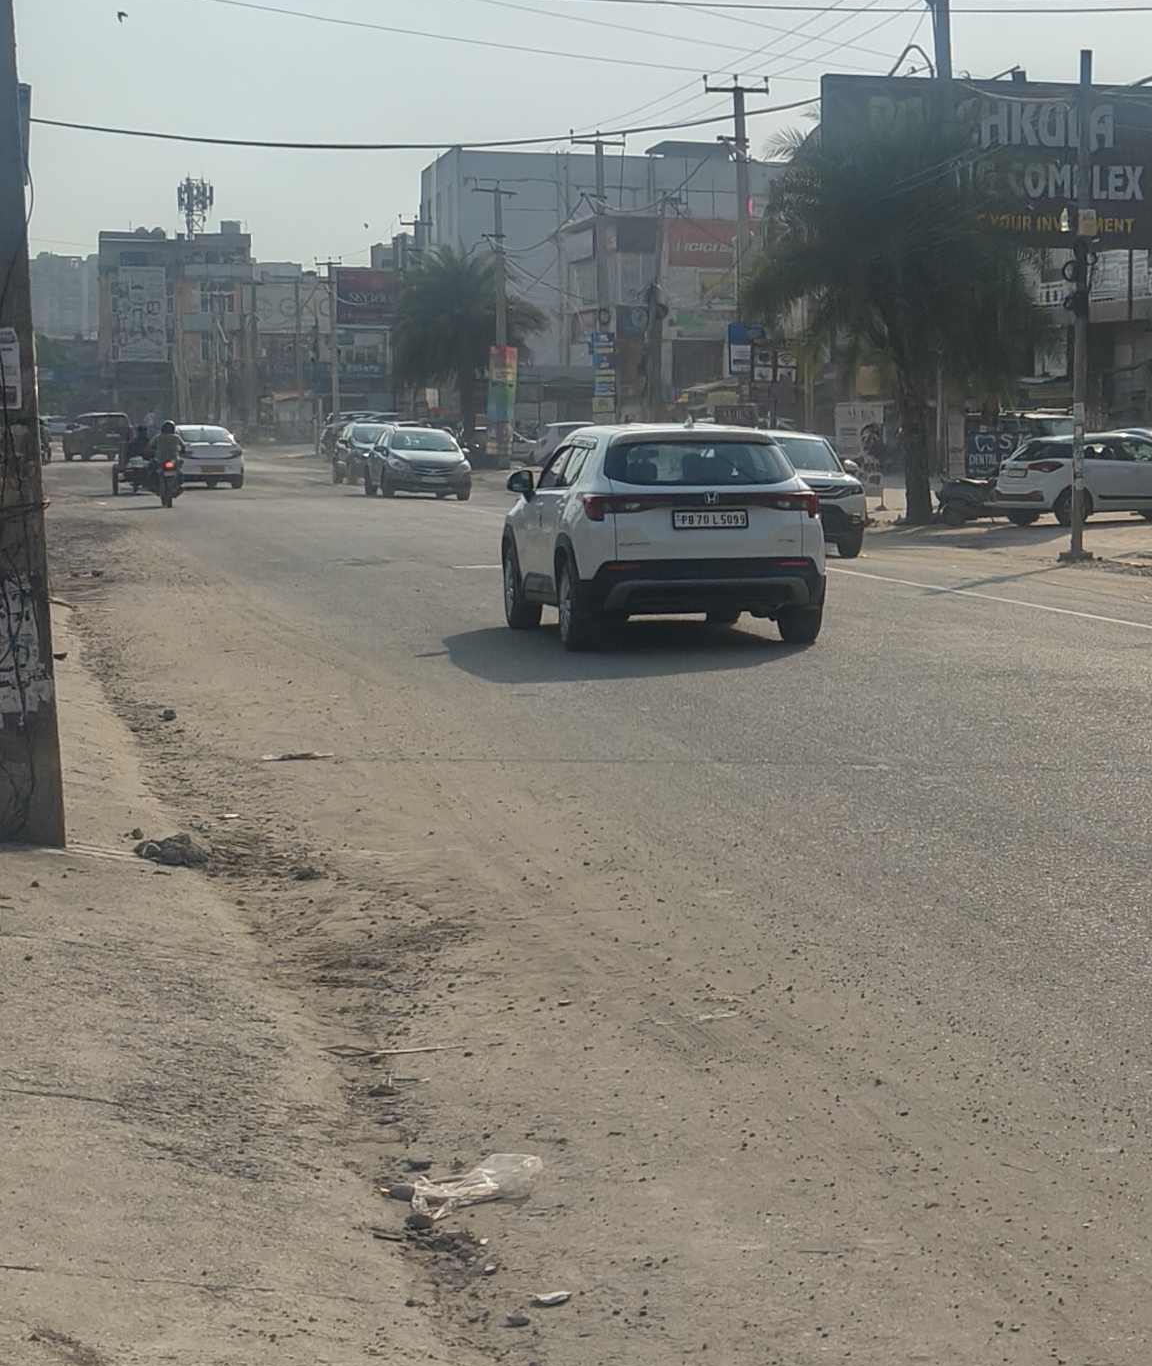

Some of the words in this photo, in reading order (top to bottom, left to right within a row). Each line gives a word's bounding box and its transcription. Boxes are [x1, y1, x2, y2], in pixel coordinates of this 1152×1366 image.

[868, 96, 1115, 152] PHKULA
[1037, 215, 1135, 233] INVMENT
[969, 454, 999, 466] DENTAL
[681, 514, 694, 525] PB
